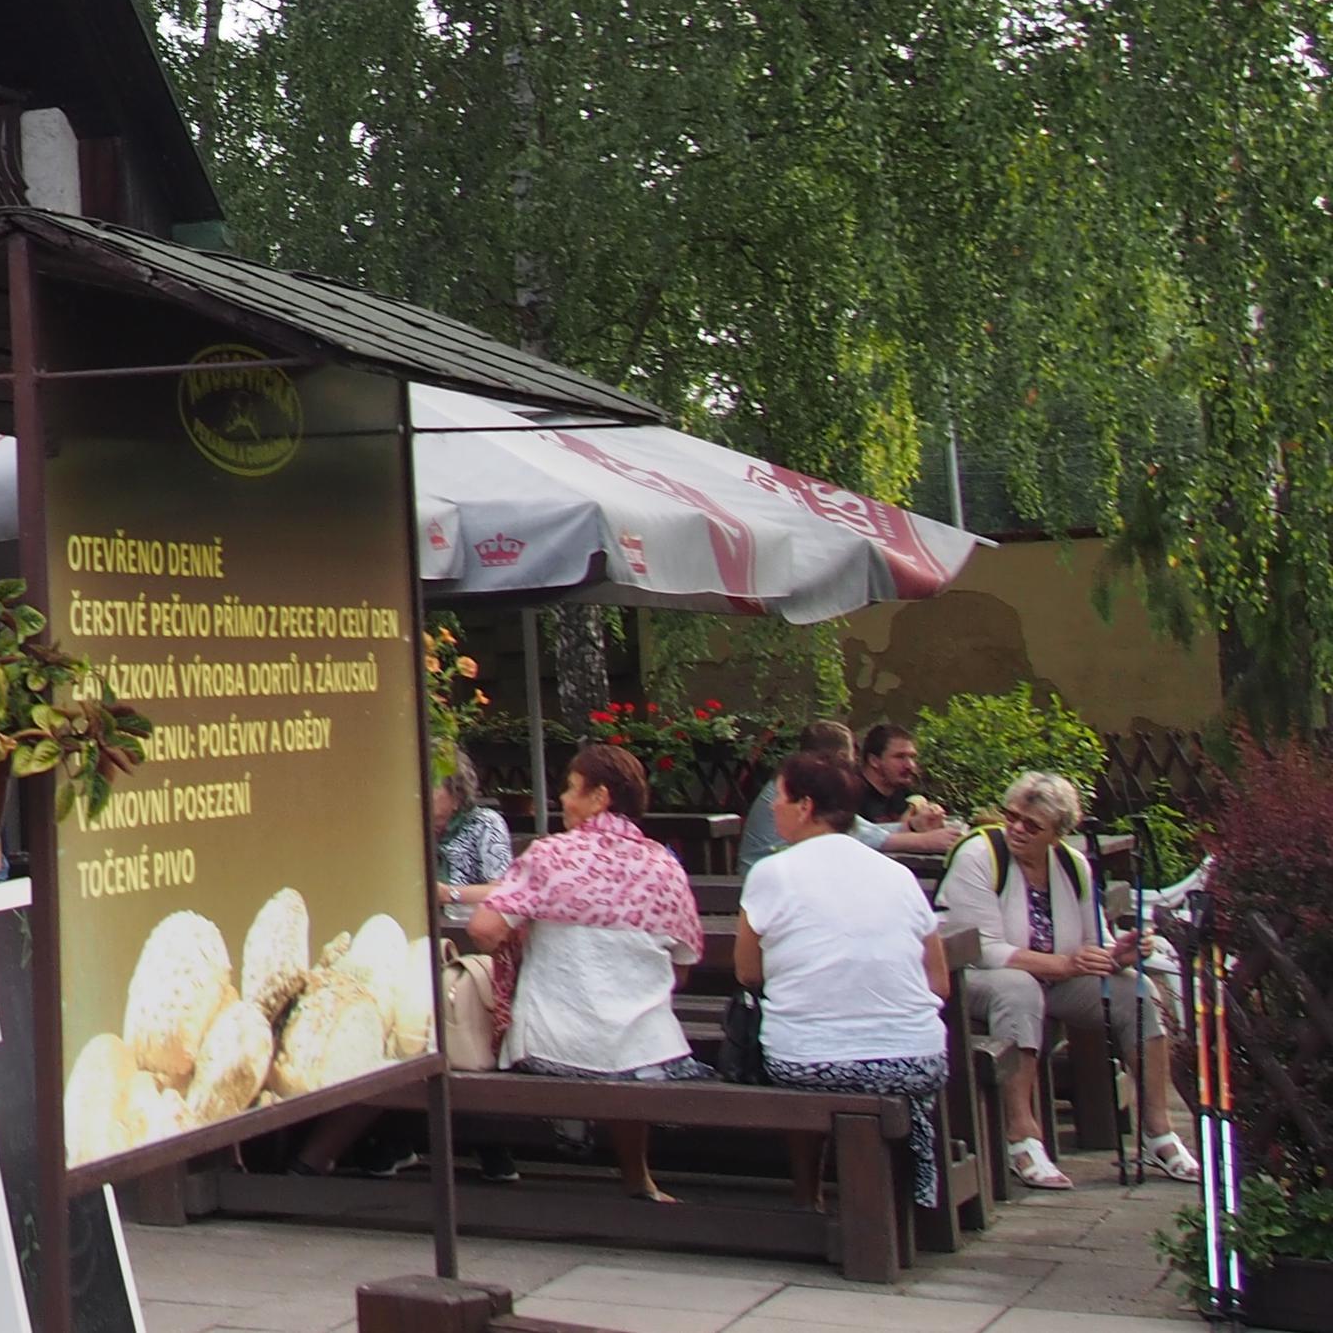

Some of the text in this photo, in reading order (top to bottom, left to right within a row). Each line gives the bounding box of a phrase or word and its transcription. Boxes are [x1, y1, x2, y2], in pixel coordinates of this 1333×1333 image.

[68, 528, 224, 578] OTEVŘENO DENNĚ
[70, 589, 400, 638] ČERSTVÉ PEČIVO PŘÍMO Z PECE PO CELÝ DEN
[179, 654, 247, 698] VÝROBA
[248, 652, 300, 695] DORTŮ
[303, 663, 315, 694] A
[315, 652, 377, 693] ZÁKUSKŮ
[198, 713, 268, 758] POLÉVKY
[270, 720, 282, 753] A
[283, 709, 331, 752] OBĚDY
[75, 771, 251, 832] VNKOVNÍ POSEZENÍ
[77, 844, 195, 899] TOČENÉ PIVO
